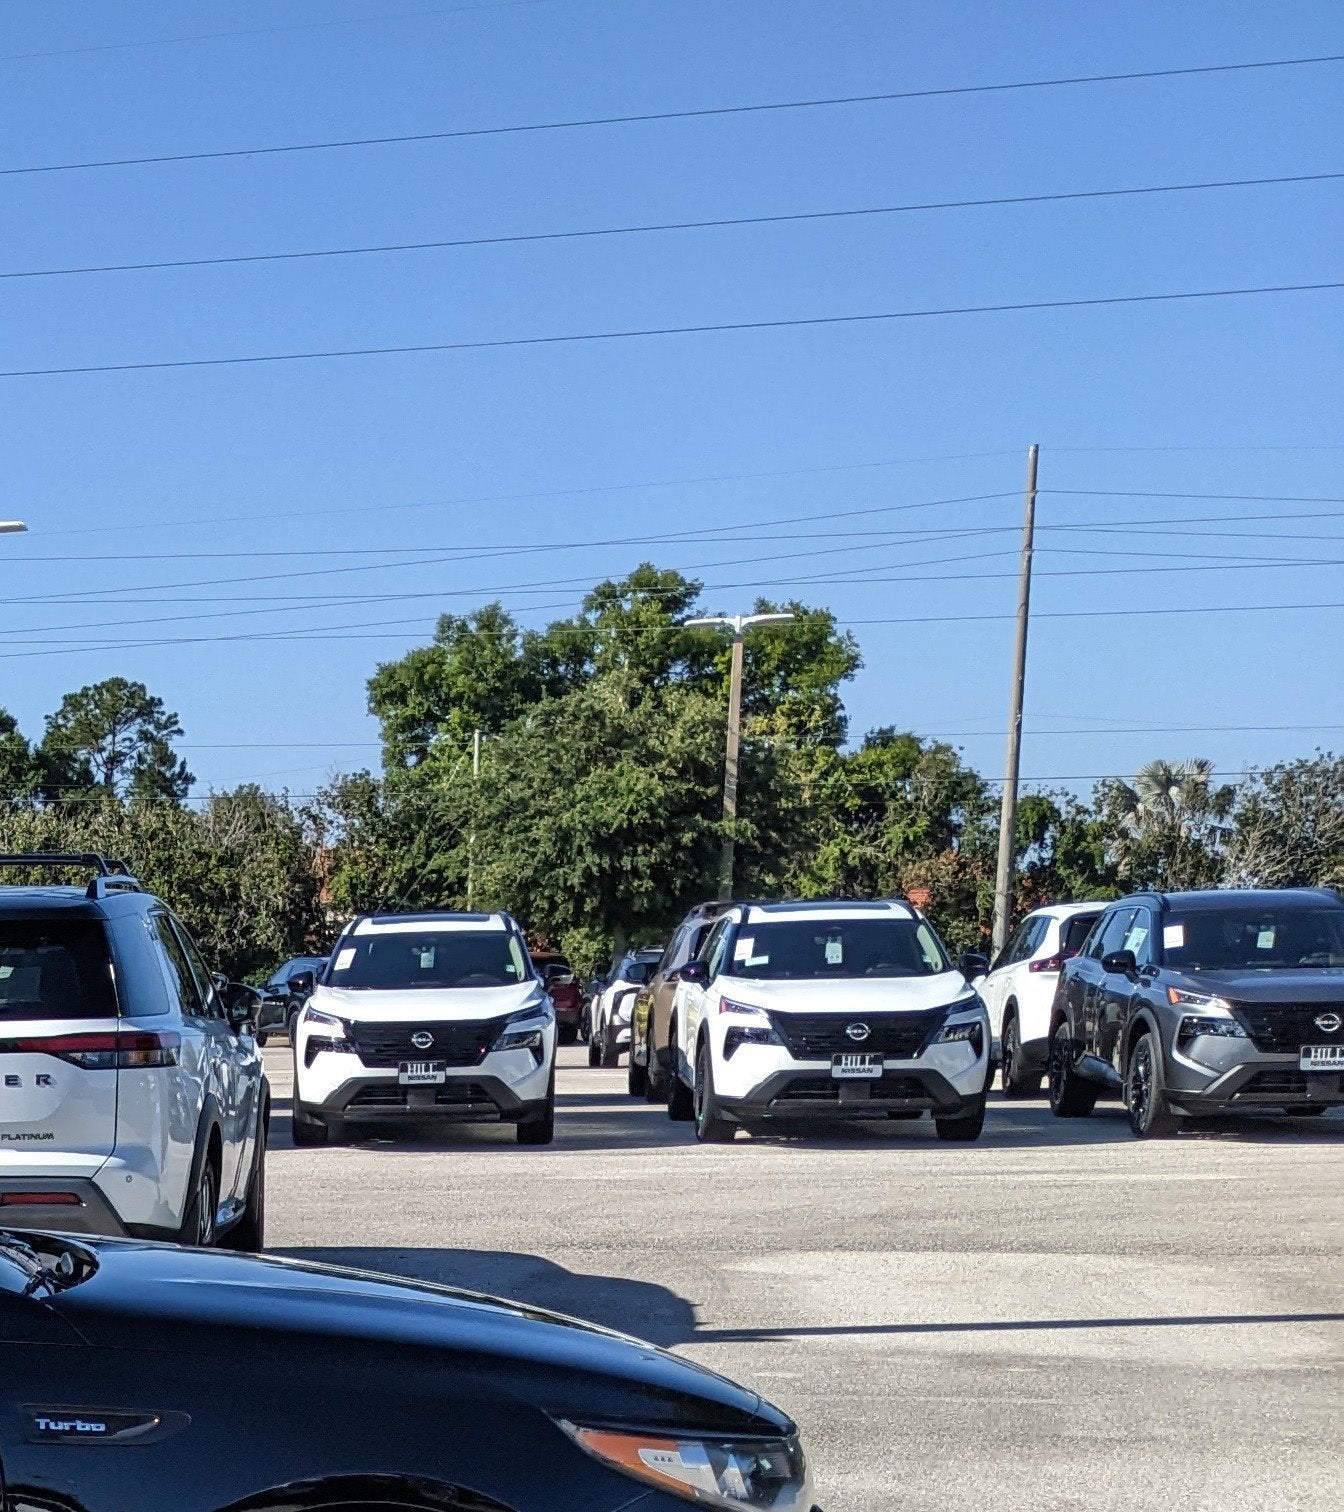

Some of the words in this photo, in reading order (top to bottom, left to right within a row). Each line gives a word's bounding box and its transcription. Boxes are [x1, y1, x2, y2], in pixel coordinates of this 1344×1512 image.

[841, 1054, 875, 1068] HILL
[407, 1062, 437, 1075] HILL
[0, 1133, 55, 1141] PLATINUM
[35, 1419, 106, 1432] Turbo
